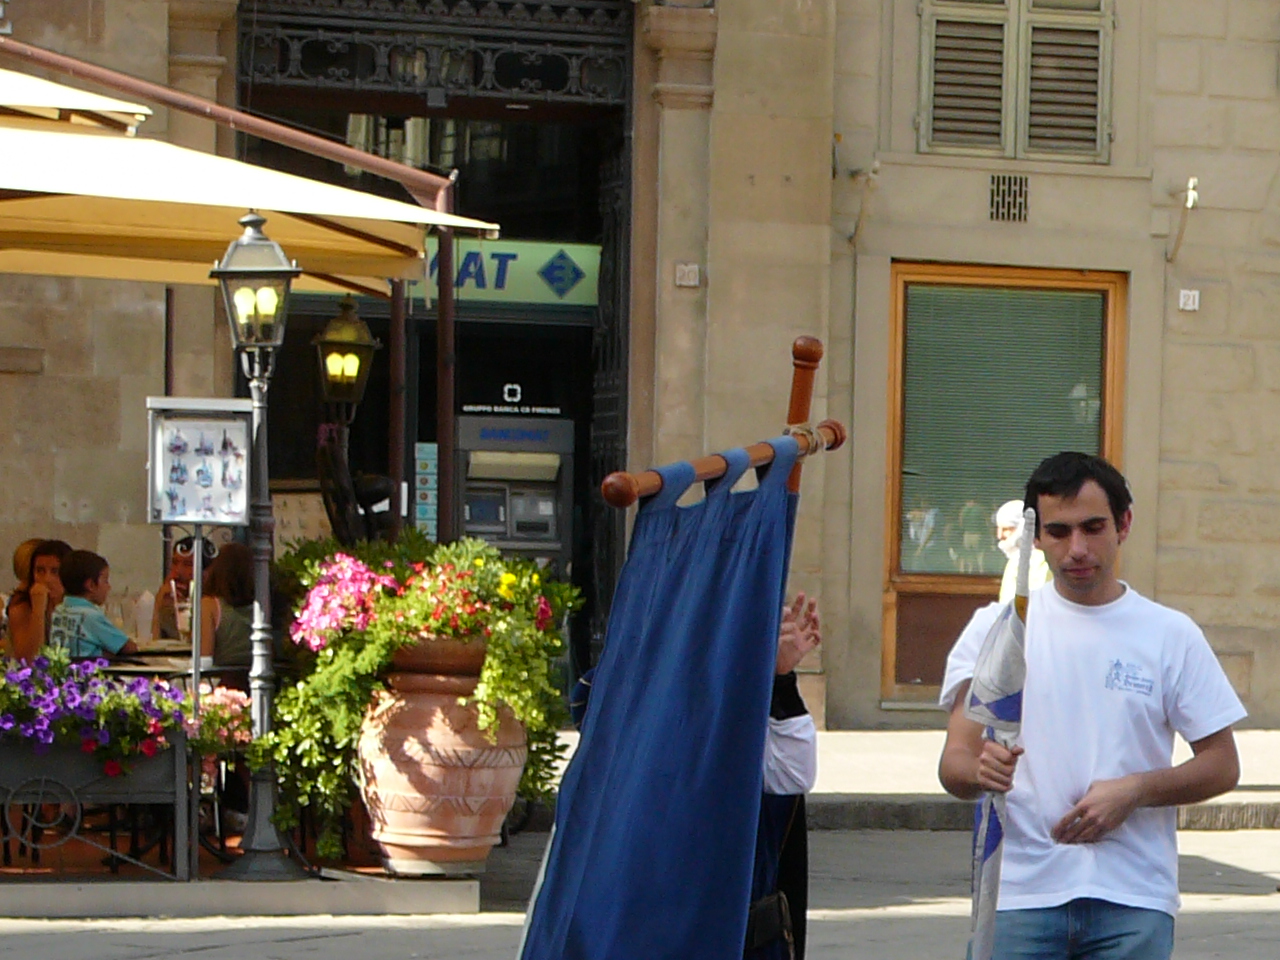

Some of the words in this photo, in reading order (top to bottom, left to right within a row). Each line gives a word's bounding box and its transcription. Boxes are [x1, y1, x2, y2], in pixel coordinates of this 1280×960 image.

[1182, 293, 1196, 308] 21
[462, 404, 492, 412] GRUPPO
[493, 405, 519, 414] BANCA
